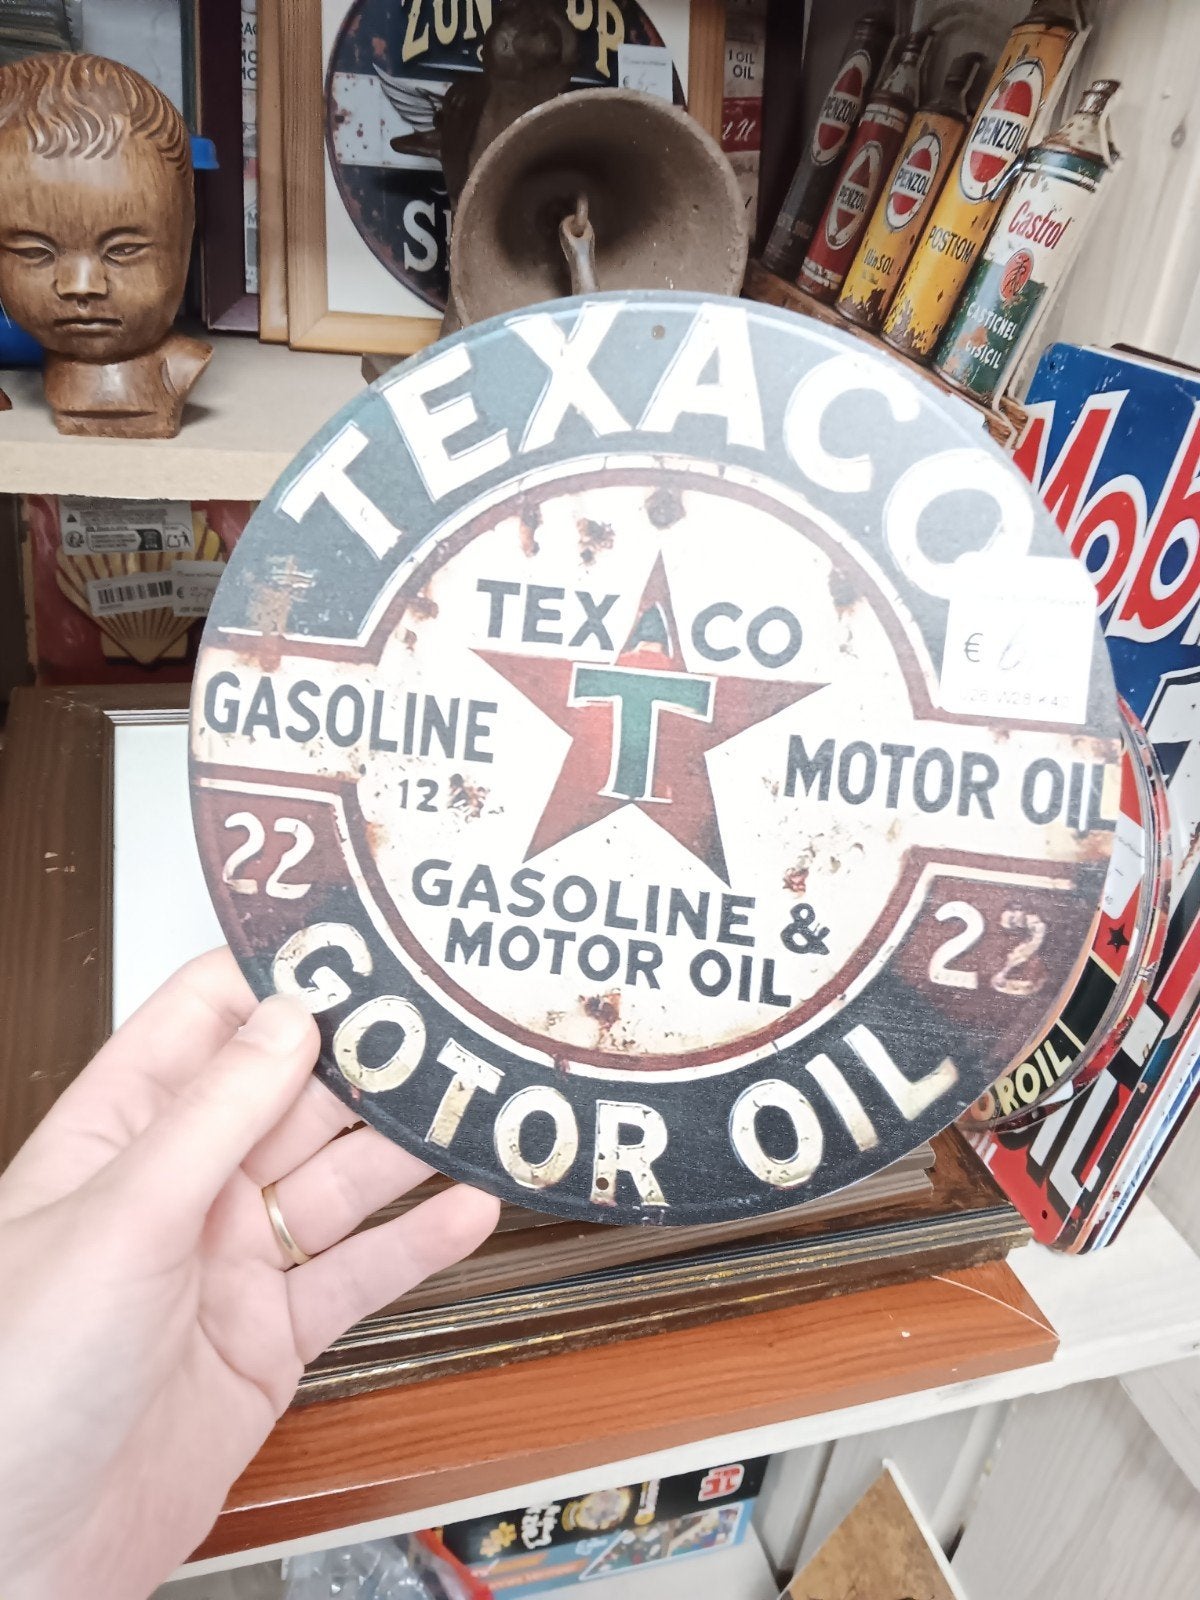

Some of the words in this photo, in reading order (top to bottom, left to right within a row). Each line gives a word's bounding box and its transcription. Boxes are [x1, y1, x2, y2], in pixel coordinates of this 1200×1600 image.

[1008, 200, 1073, 250] Castrol
[275, 301, 1034, 600] TEXACO
[1010, 388, 1200, 645] Mob
[202, 671, 498, 764] GASOLINE
[566, 661, 717, 804] T
[784, 734, 1000, 820] MOTOR
[1020, 757, 1118, 832] OIL
[221, 811, 315, 900] 22
[412, 858, 756, 947] GASOLINE
[779, 902, 830, 956] &
[928, 900, 1048, 995] 22
[444, 917, 664, 990] MOTOR
[688, 949, 792, 1008] OIL
[272, 921, 669, 1208] GOTOR
[729, 1023, 960, 1187] OIL
